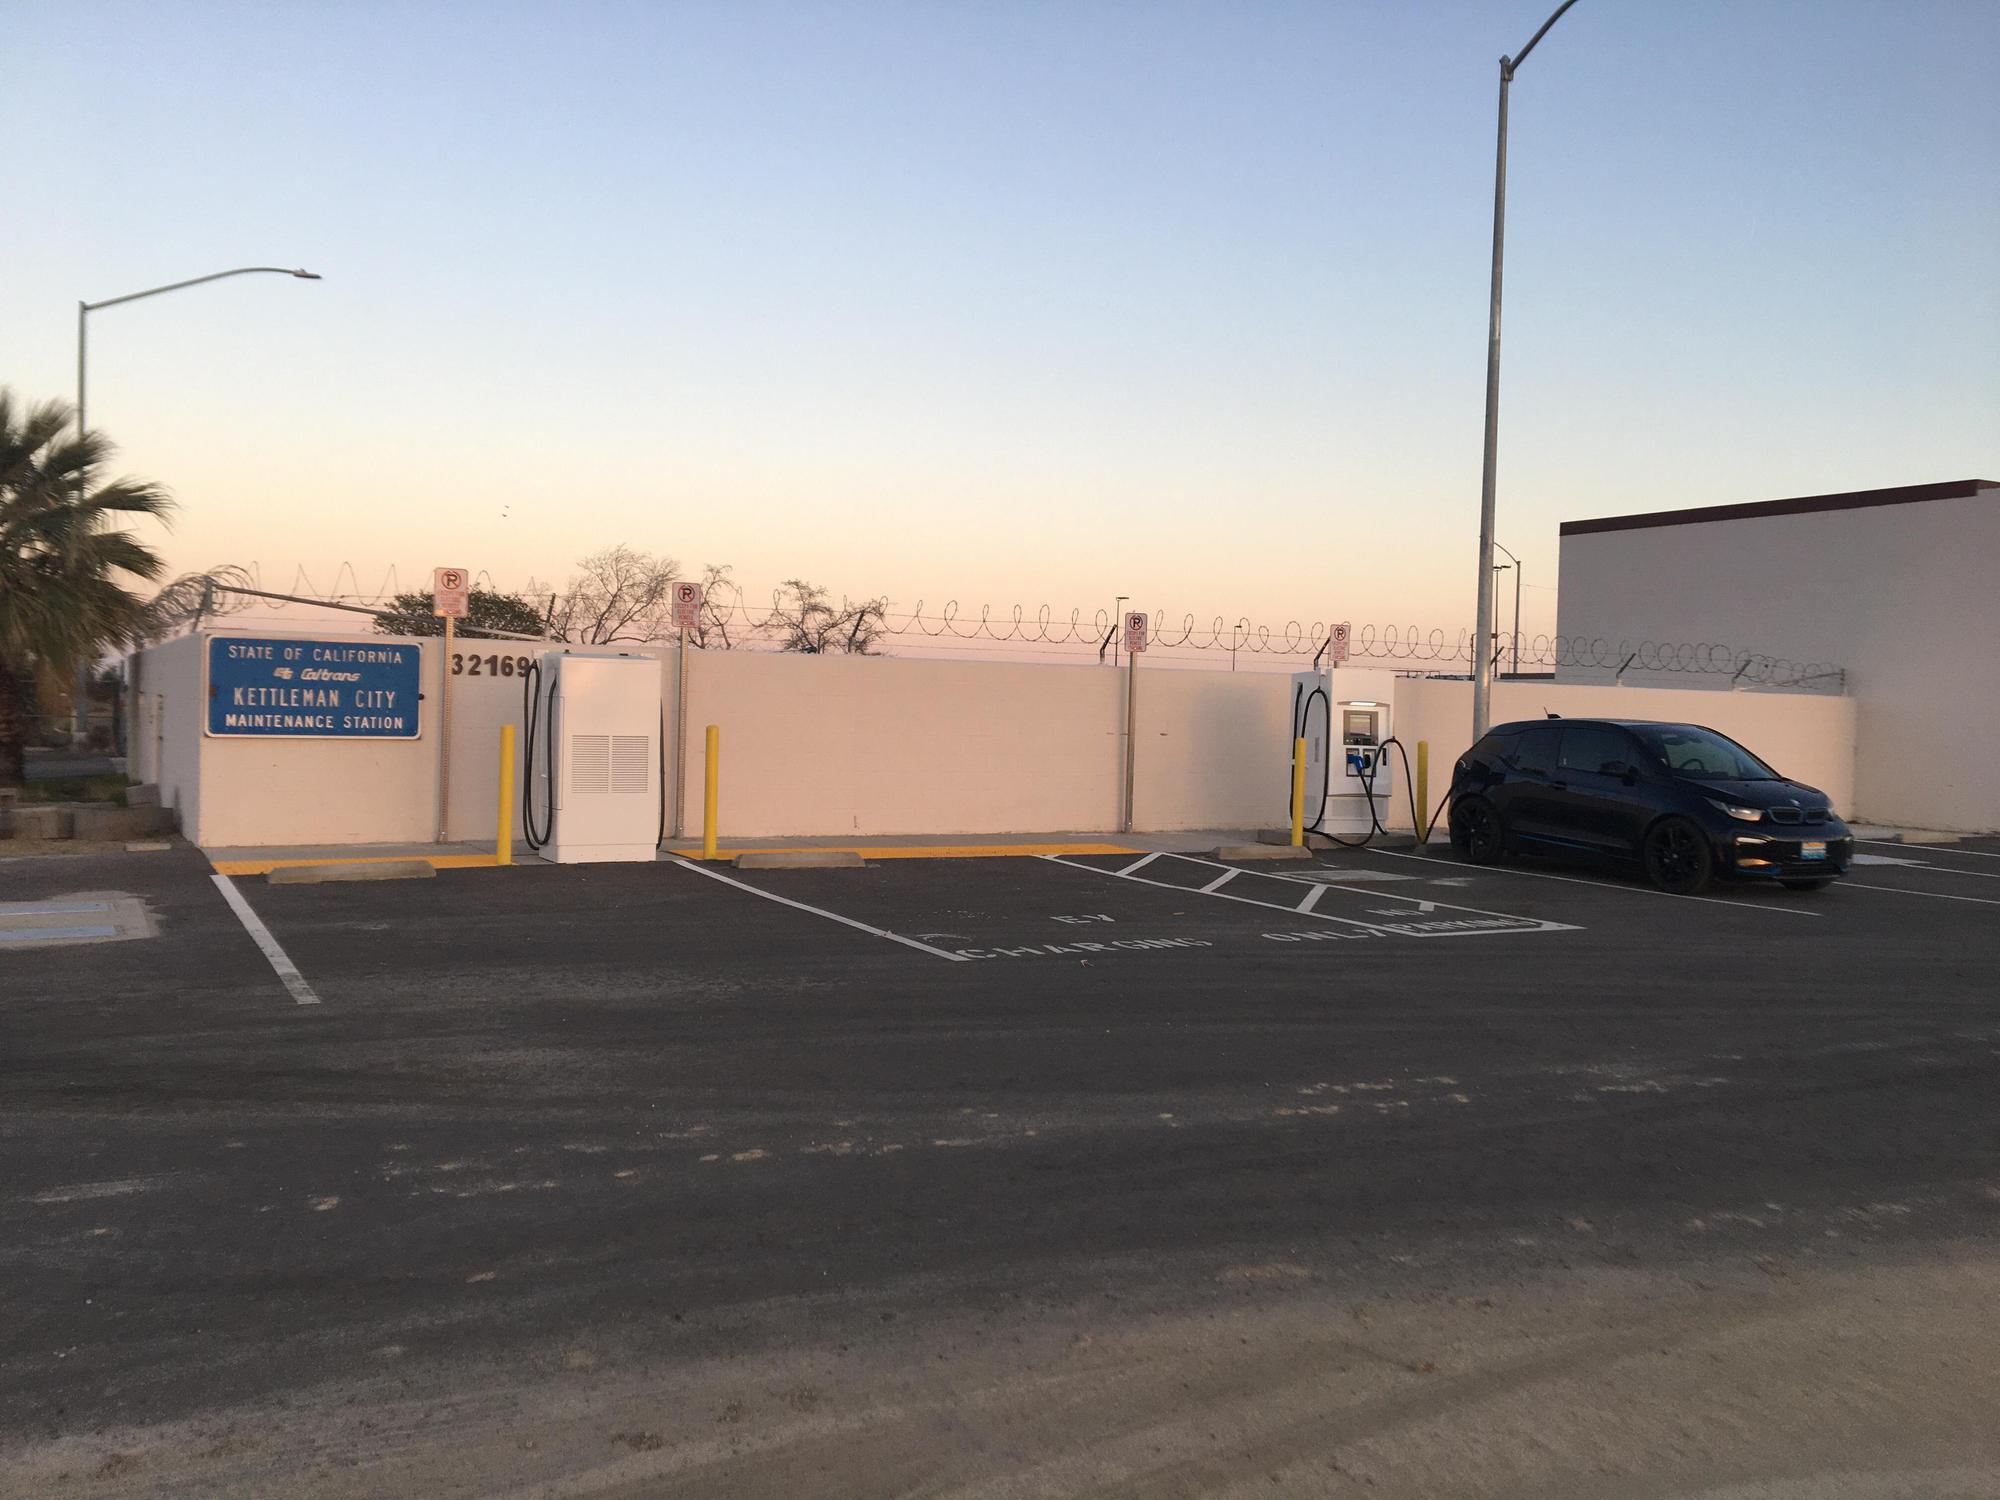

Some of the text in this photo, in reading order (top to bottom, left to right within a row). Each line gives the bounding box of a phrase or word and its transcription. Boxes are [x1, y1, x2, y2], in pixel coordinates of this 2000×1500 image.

[228, 645, 402, 664] STATE OF CALIFORNIA
[452, 653, 530, 678] 32169
[300, 668, 362, 682] Caltrans
[234, 687, 396, 709] KETTLEMAN CITY
[225, 714, 403, 729] MAINTENANCE STATION
[1049, 914, 1117, 924] EV
[1384, 918, 1537, 932] PARKING
[955, 928, 1387, 959] CHARGING ONLY
